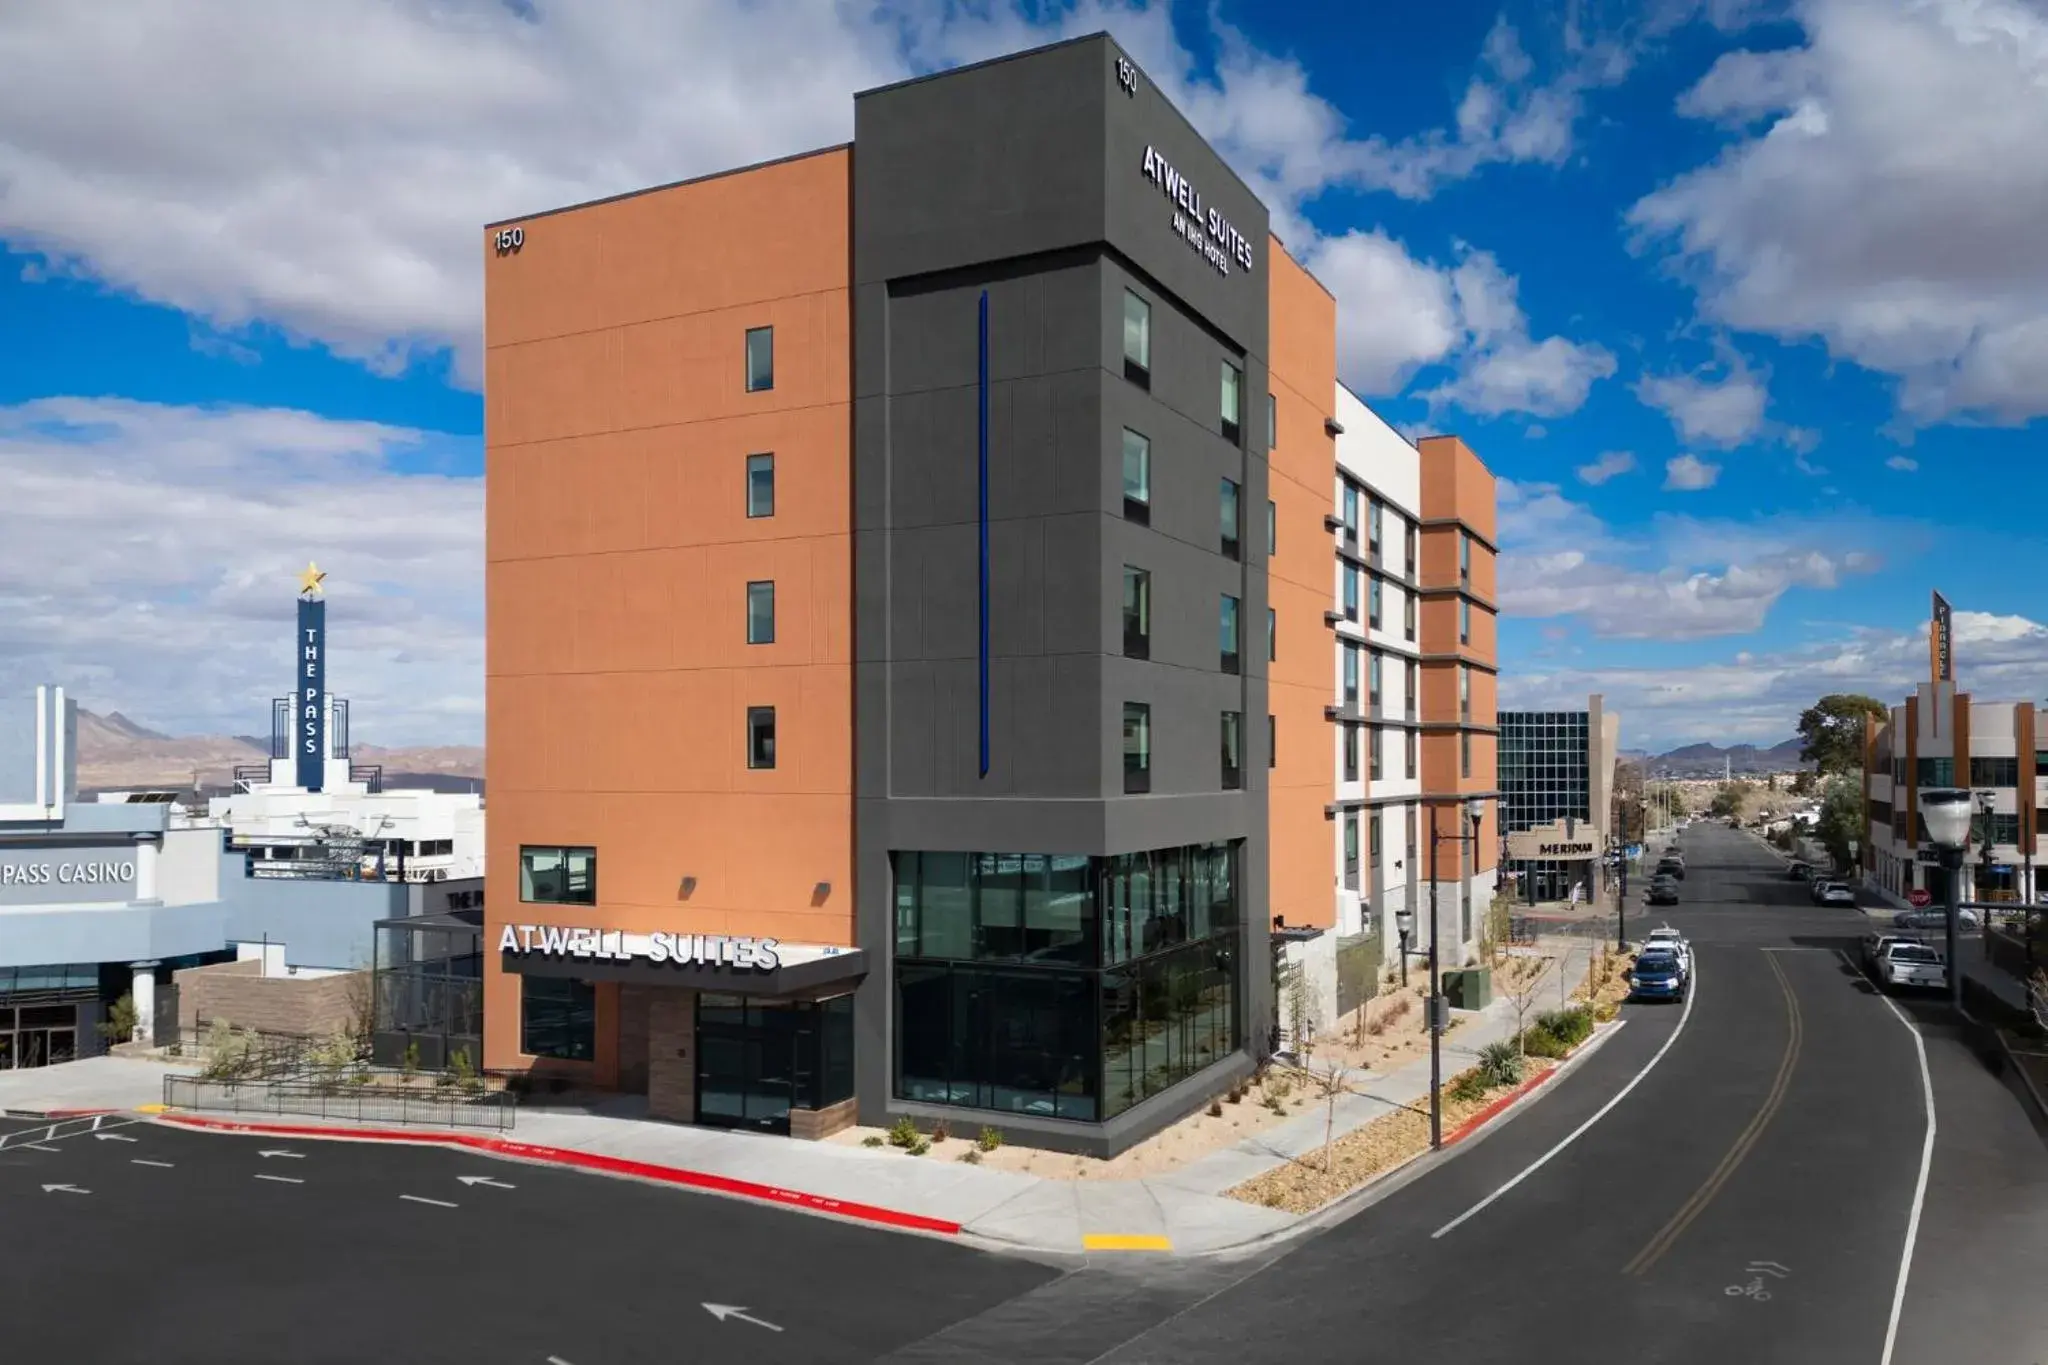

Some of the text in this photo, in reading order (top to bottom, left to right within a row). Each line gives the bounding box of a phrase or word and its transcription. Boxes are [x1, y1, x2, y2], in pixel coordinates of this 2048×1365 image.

[1117, 57, 1137, 92] 150
[1143, 145, 1252, 269] ATWELL SUITES
[495, 227, 523, 250] 150
[1173, 211, 1229, 275] AN IHG HOTEL
[305, 629, 317, 753] THE PASS
[2, 861, 135, 884] PASS CASINO
[499, 924, 778, 971] ATWELL SUITES
